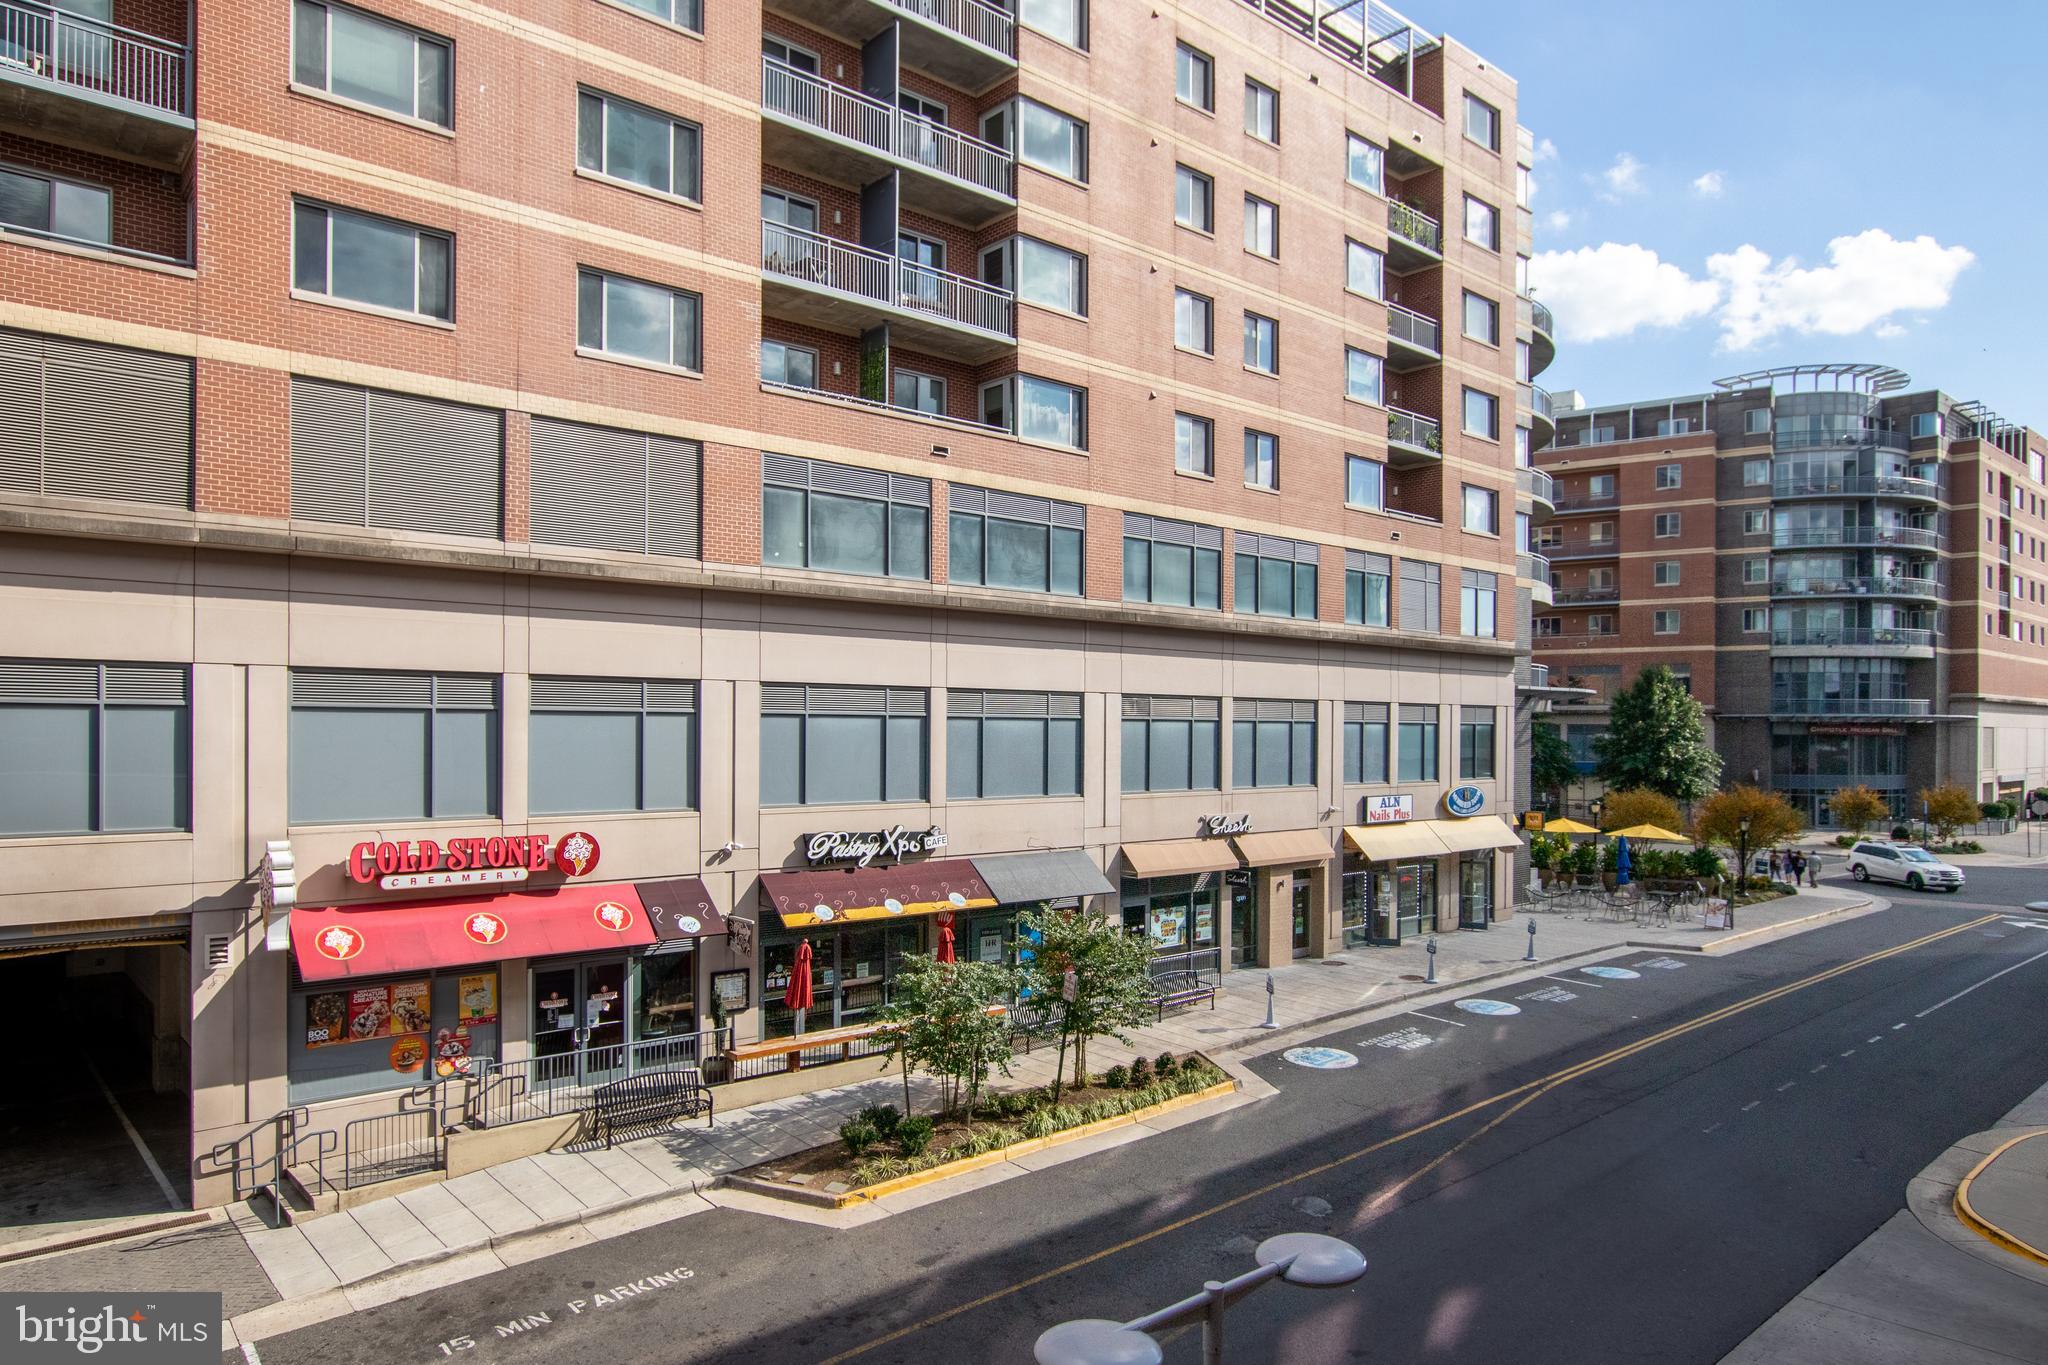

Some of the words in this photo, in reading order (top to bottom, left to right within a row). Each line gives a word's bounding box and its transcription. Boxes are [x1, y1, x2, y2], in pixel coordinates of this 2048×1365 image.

[1380, 796, 1401, 808] ALN
[1369, 809, 1391, 821] Nails
[1393, 808, 1410, 820] Plus
[807, 831, 880, 868] Pastry
[879, 825, 921, 865] Xpo
[925, 835, 947, 849] CAFE
[349, 839, 441, 884] COLD
[446, 834, 549, 872] STONE
[391, 870, 520, 888] CREAMERY
[353, 989, 388, 999] SIGNATURE
[353, 994, 388, 1004] CREATIONS
[308, 1029, 329, 1038] BOO
[437, 1334, 476, 1356] 15
[493, 1311, 553, 1338] MIN
[567, 1267, 695, 1314] PARKING
